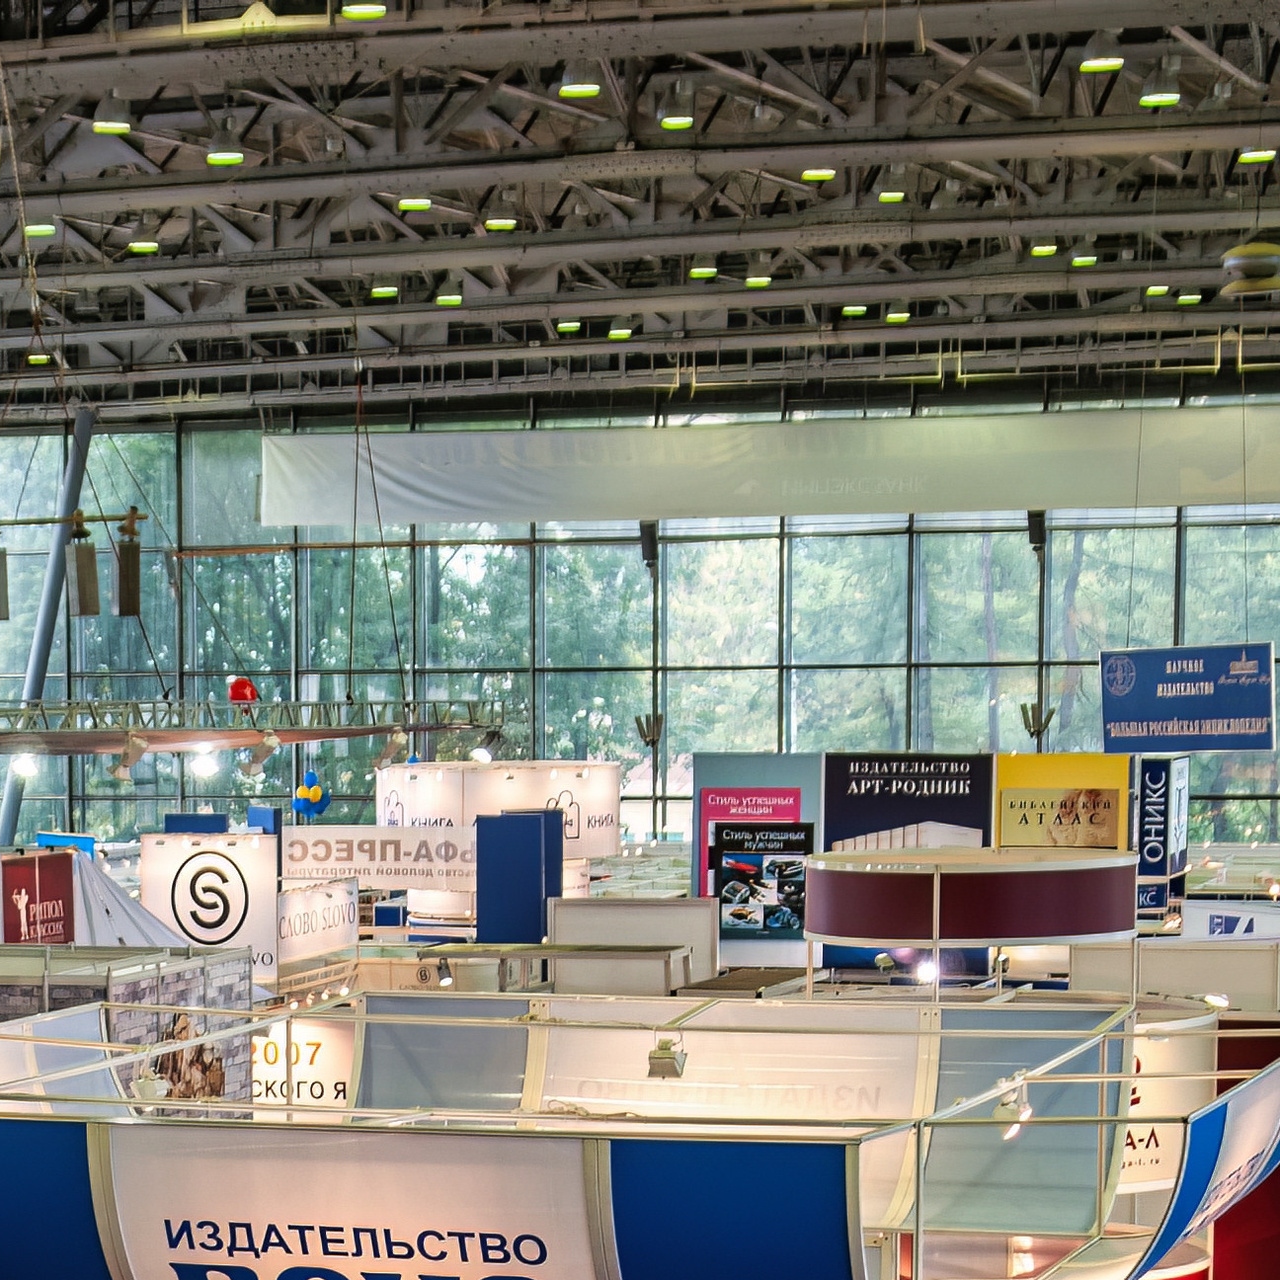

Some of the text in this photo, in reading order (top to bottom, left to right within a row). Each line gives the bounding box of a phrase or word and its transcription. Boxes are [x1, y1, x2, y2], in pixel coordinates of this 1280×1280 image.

[1157, 681, 1214, 698] ИЗДАТЕЛЬСТВО
[849, 761, 970, 775] ИЗДАТЕЛЬСТВО
[847, 779, 971, 797] АРТ-РОДНИК
[708, 794, 795, 807] Стиль успешных
[587, 813, 616, 829] КНИГА
[1019, 812, 1104, 826] АТЛАС
[1143, 771, 1167, 863] ОНИКС
[722, 829, 806, 843] Стиль успешных
[321, 901, 357, 931] SLOVO
[164, 1217, 548, 1267] ИЗДАТЕЛЬСТВО
